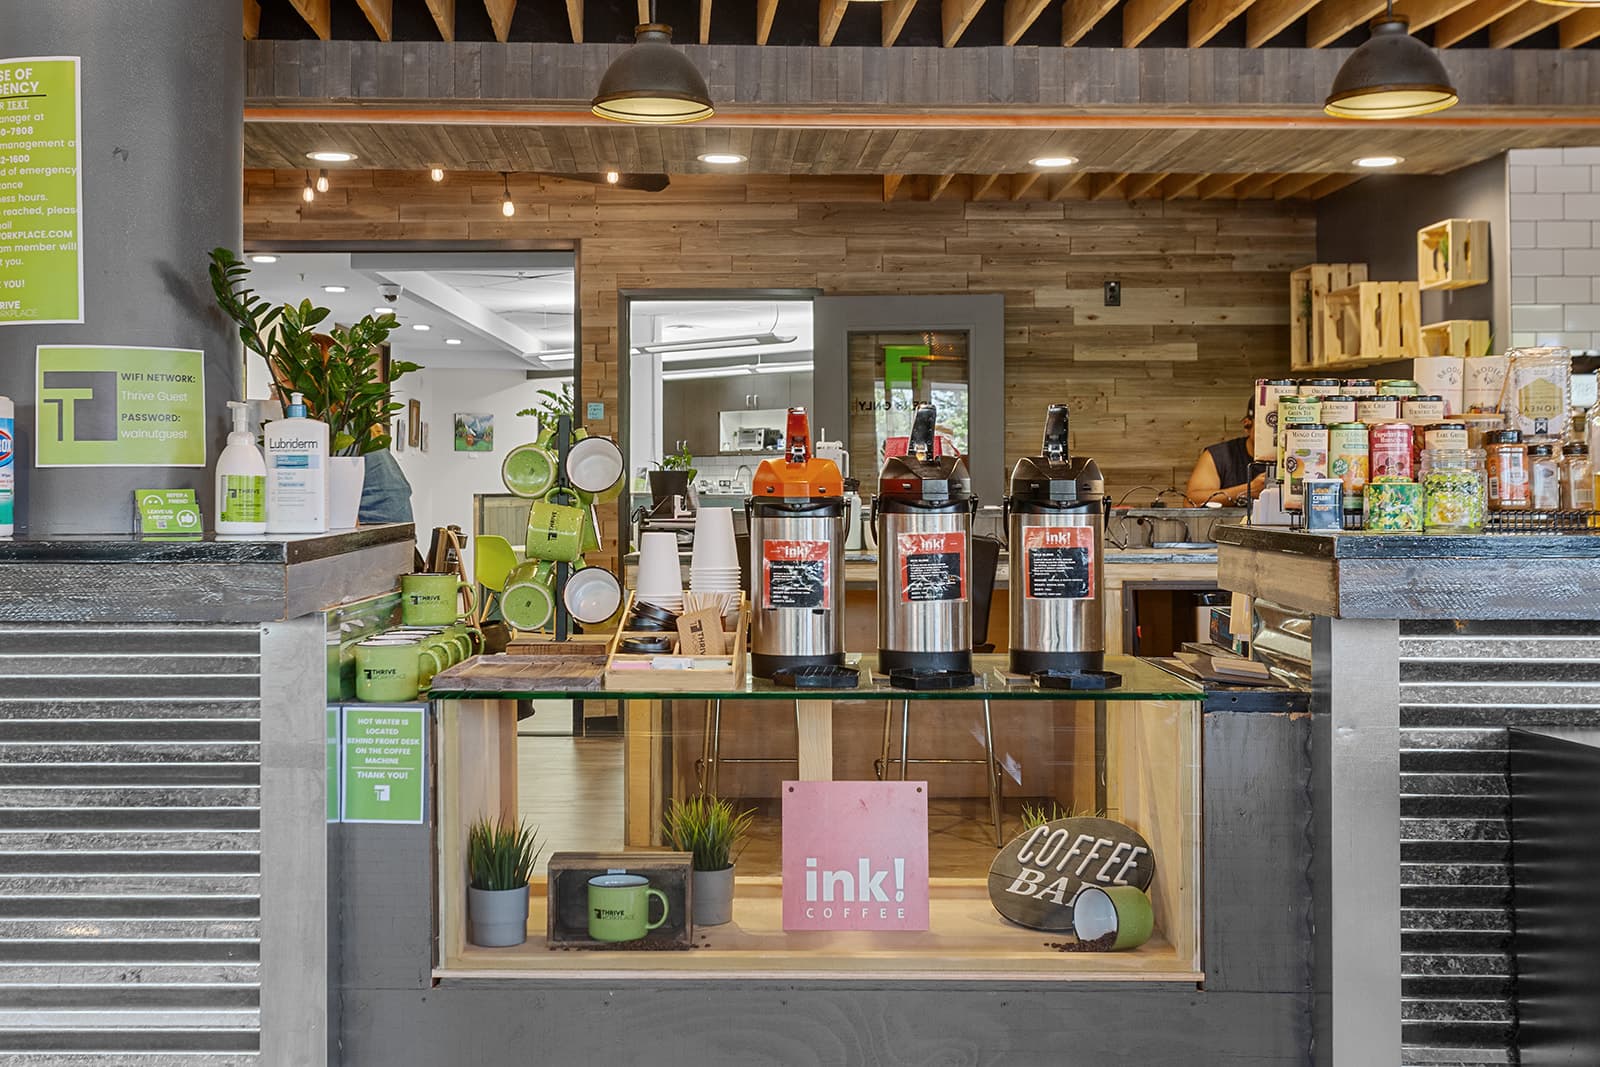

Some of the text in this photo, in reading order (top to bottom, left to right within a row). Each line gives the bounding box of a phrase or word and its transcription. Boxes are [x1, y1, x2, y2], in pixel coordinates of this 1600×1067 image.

[15, 68, 33, 80] OF
[7, 100, 29, 111] TEXT
[8, 167, 17, 175] of
[20, 167, 77, 177] emergency
[19, 193, 48, 202] hours.
[14, 243, 56, 253] member
[59, 242, 77, 251] will
[5, 258, 24, 268] you.
[4, 279, 25, 289] YOU!
[121, 373, 196, 383] WIFI NETWORK:
[121, 390, 188, 402] Thrive Guest
[121, 413, 181, 422] PASSWORD:
[121, 429, 188, 441] walnutguest
[269, 437, 318, 449] Lubriderm
[1045, 531, 1071, 545] ink!
[921, 538, 945, 551] ink!
[784, 545, 809, 558] ink!
[358, 717, 373, 725] HOT
[375, 718, 400, 726] WATER
[347, 737, 374, 745] BEHIND
[375, 737, 399, 745] FRONT
[357, 771, 408, 780] THANK YOU!
[1017, 825, 1148, 885] COFFEE
[806, 857, 905, 903] ink!
[806, 907, 905, 919] COFFEE
